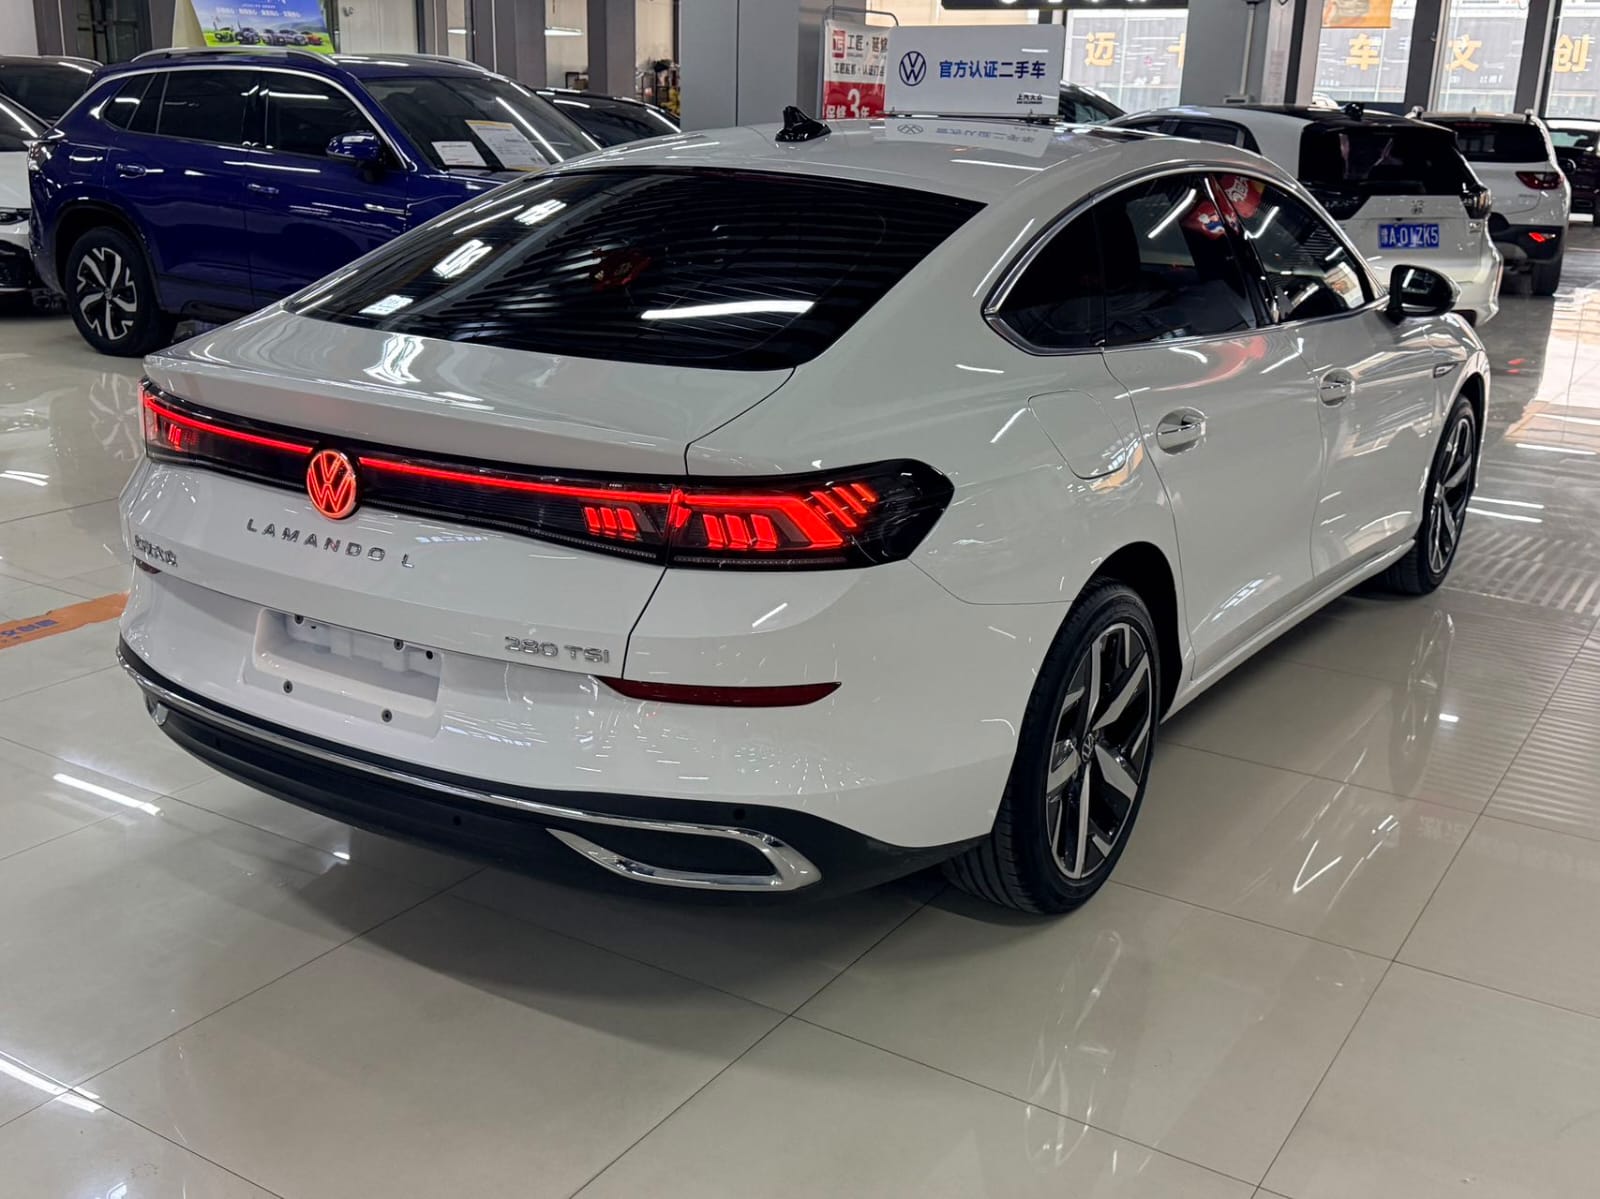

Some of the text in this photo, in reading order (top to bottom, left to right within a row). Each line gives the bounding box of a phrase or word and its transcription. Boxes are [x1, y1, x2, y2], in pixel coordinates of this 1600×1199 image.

[1085, 32, 1591, 72] 迈 车 文 创
[939, 60, 1046, 78] 官方认证二手车
[246, 518, 416, 568] LAMANDO L
[563, 645, 610, 664] TSI
